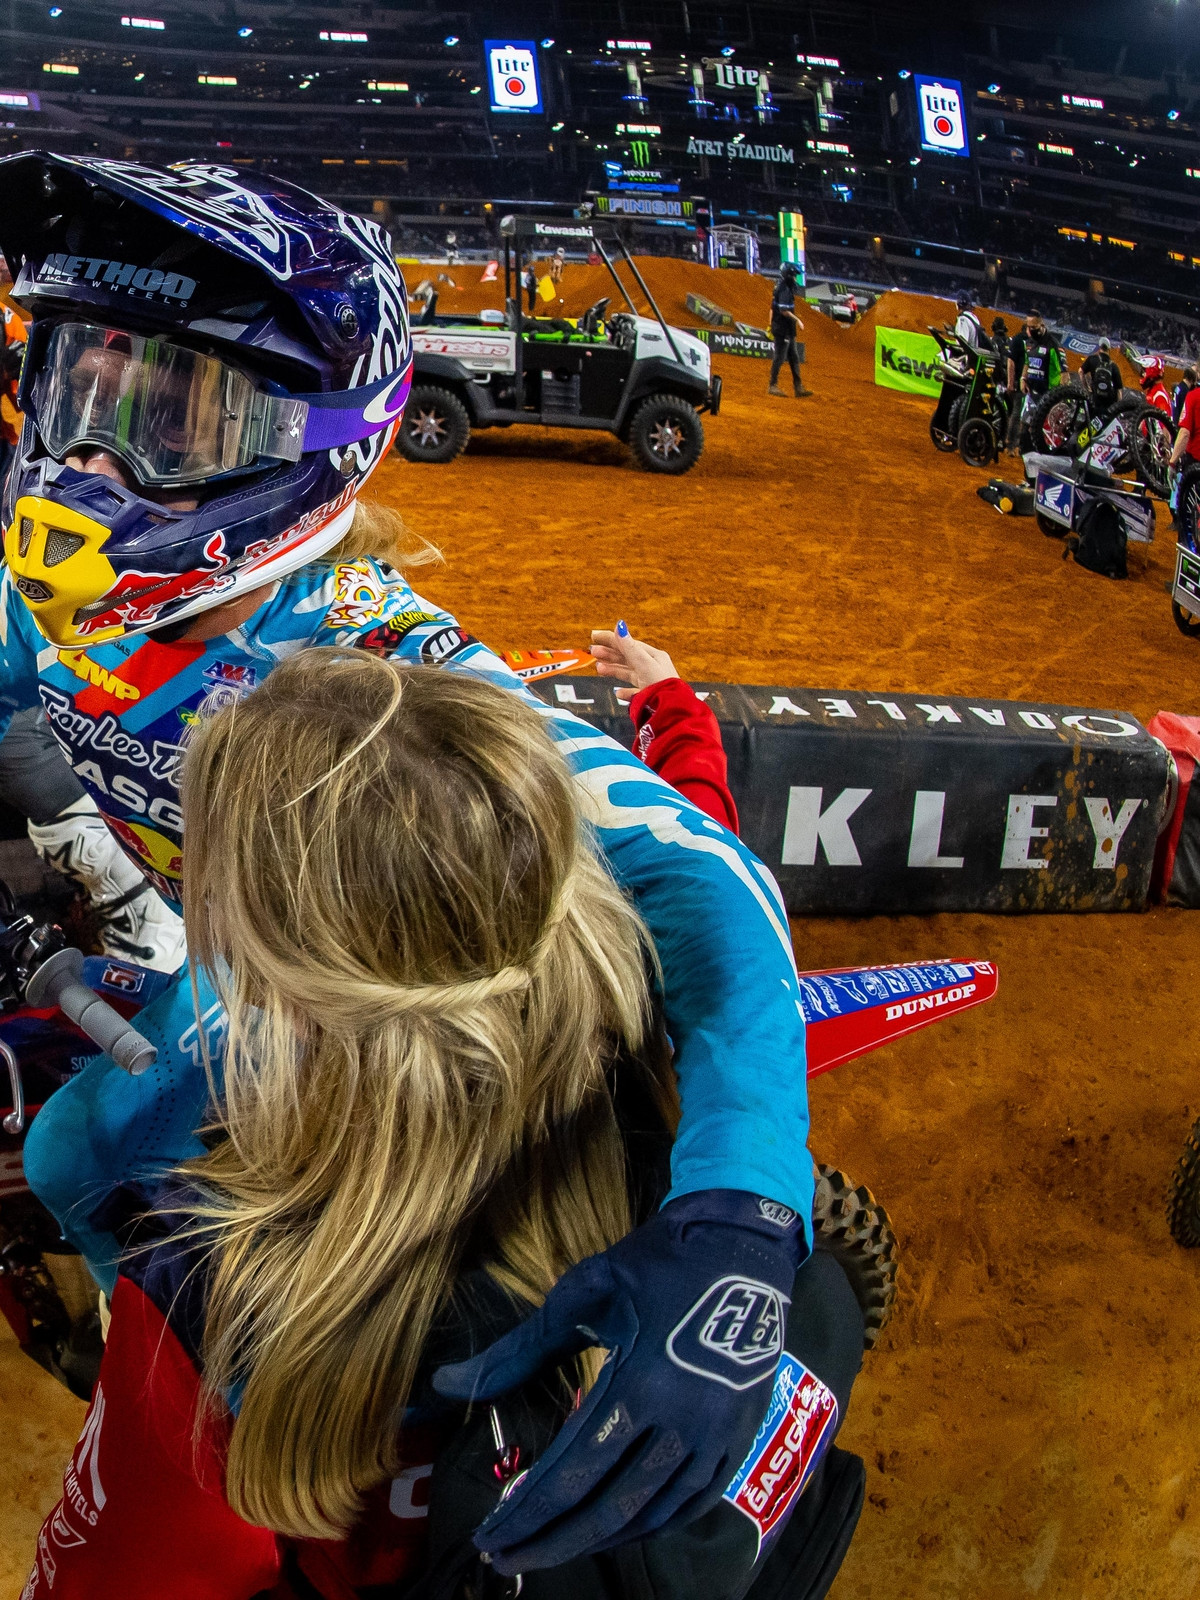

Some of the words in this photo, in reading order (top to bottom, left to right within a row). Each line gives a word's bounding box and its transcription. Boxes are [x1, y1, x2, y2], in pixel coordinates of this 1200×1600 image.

[497, 58, 530, 76] Lite
[714, 62, 759, 90] Lite
[925, 94, 957, 113] Lite
[686, 138, 725, 157] AT&T
[726, 144, 795, 164] STADIUM
[608, 197, 682, 217] FINISH
[535, 222, 594, 238] Kawasaki
[36, 274, 73, 285] RACE
[92, 280, 188, 308] WHEELS
[39, 252, 198, 300] METHOD
[714, 334, 776, 351] MONSTER
[1091, 425, 1121, 460] HODA
[110, 640, 131, 658] GAS
[57, 648, 141, 701] 4WP
[202, 658, 258, 689] AMA
[38, 684, 97, 748] Troy
[90, 715, 151, 767] Lee
[51, 726, 186, 834] ASG
[780, 785, 1145, 870] KLEY
[103, 964, 146, 993] 51
[885, 984, 977, 1022] DUNLOP
[70, 1054, 101, 1072] SON
[64, 1472, 99, 1527] HOTELS
